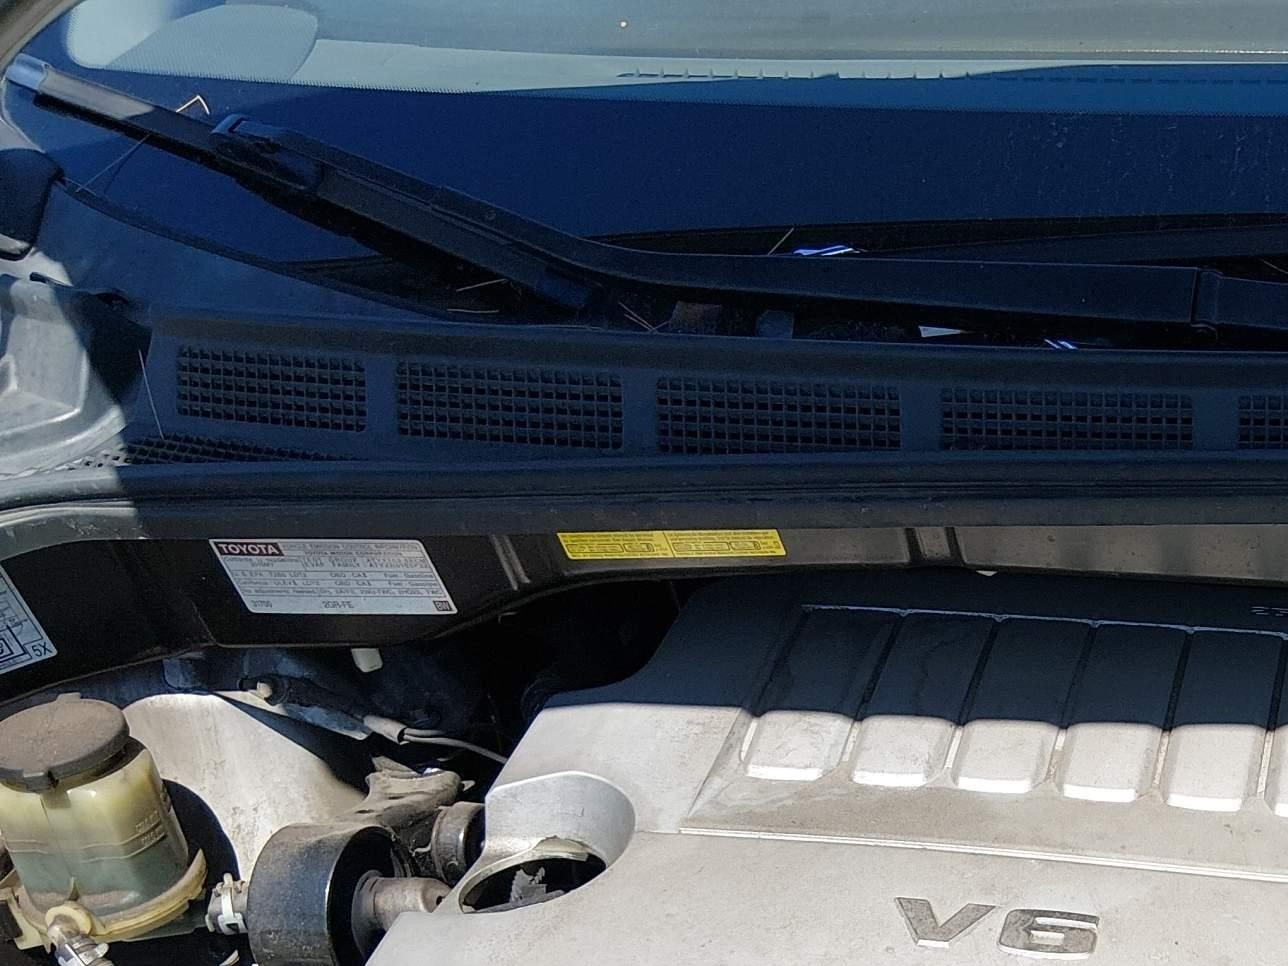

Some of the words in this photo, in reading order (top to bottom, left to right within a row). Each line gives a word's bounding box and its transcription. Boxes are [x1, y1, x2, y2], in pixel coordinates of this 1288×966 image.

[219, 544, 280, 555] TOYOTA
[31, 641, 53, 658] 5X
[895, 896, 1100, 960] V6
